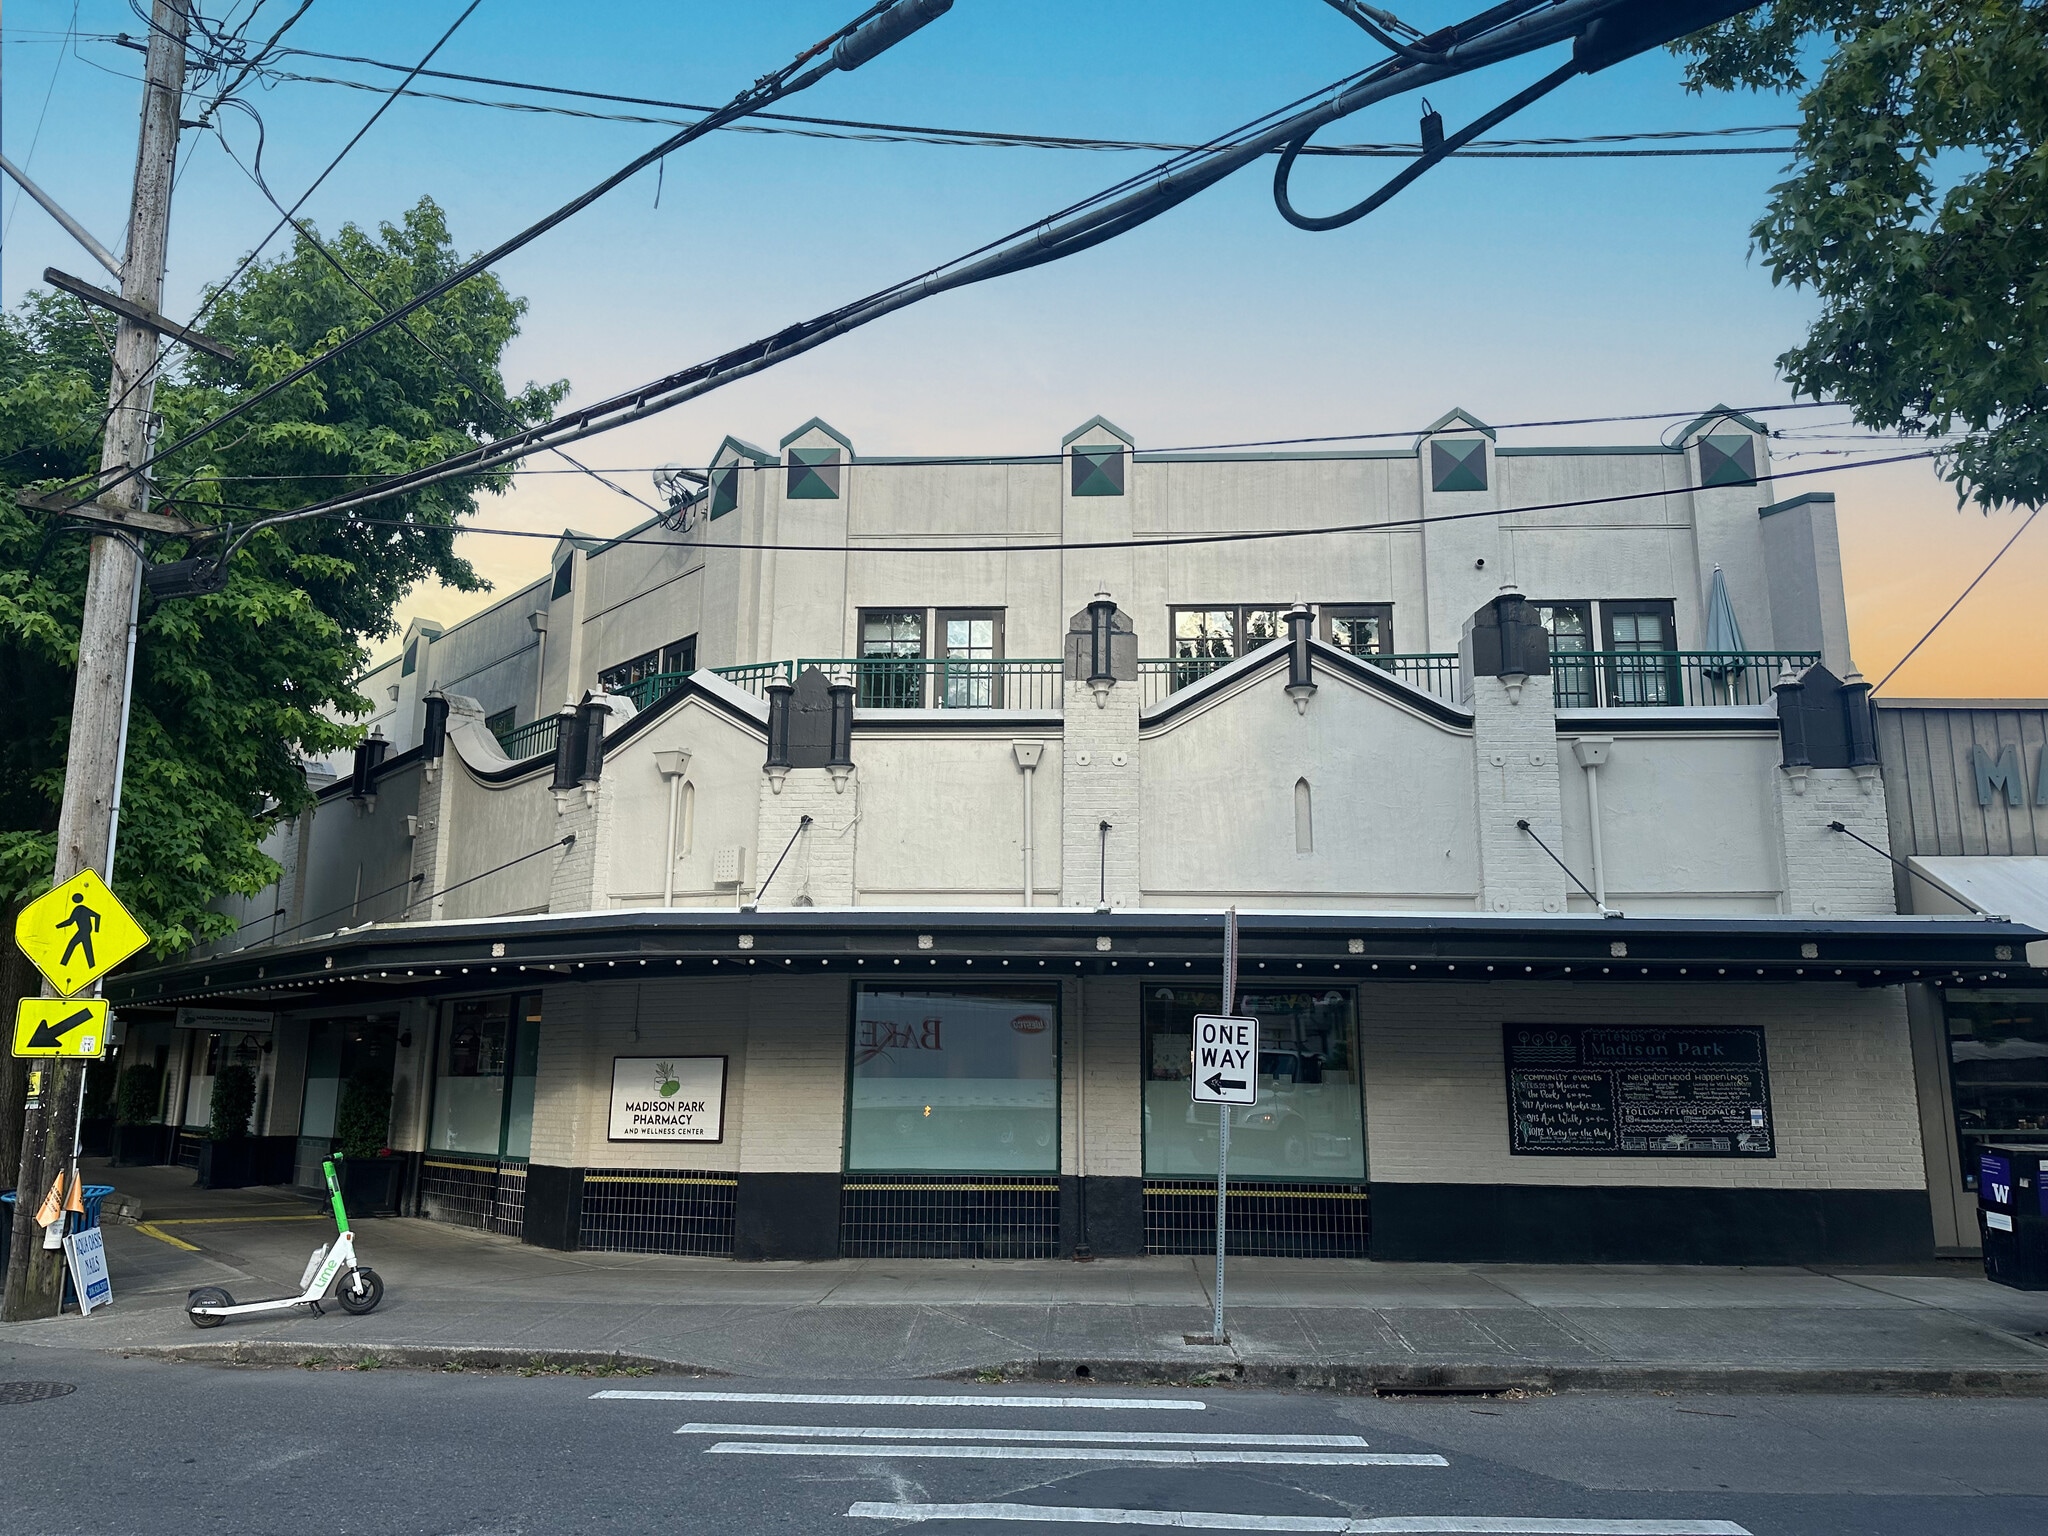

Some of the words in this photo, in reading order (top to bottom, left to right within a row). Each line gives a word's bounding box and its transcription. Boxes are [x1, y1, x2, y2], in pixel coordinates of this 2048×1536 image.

[1973, 744, 2048, 805] M
[1203, 1024, 1249, 1046] ONE
[1202, 1048, 1250, 1069] WAY
[1591, 1042, 1668, 1056] Madison
[1678, 1042, 1725, 1056] Park
[625, 1101, 676, 1112] MADISON
[678, 1101, 705, 1112] PARK
[633, 1114, 693, 1125] PHARMACY
[1547, 1127, 1568, 1141] Party
[1991, 1183, 2009, 1204] W
[314, 1260, 337, 1287] Lime
